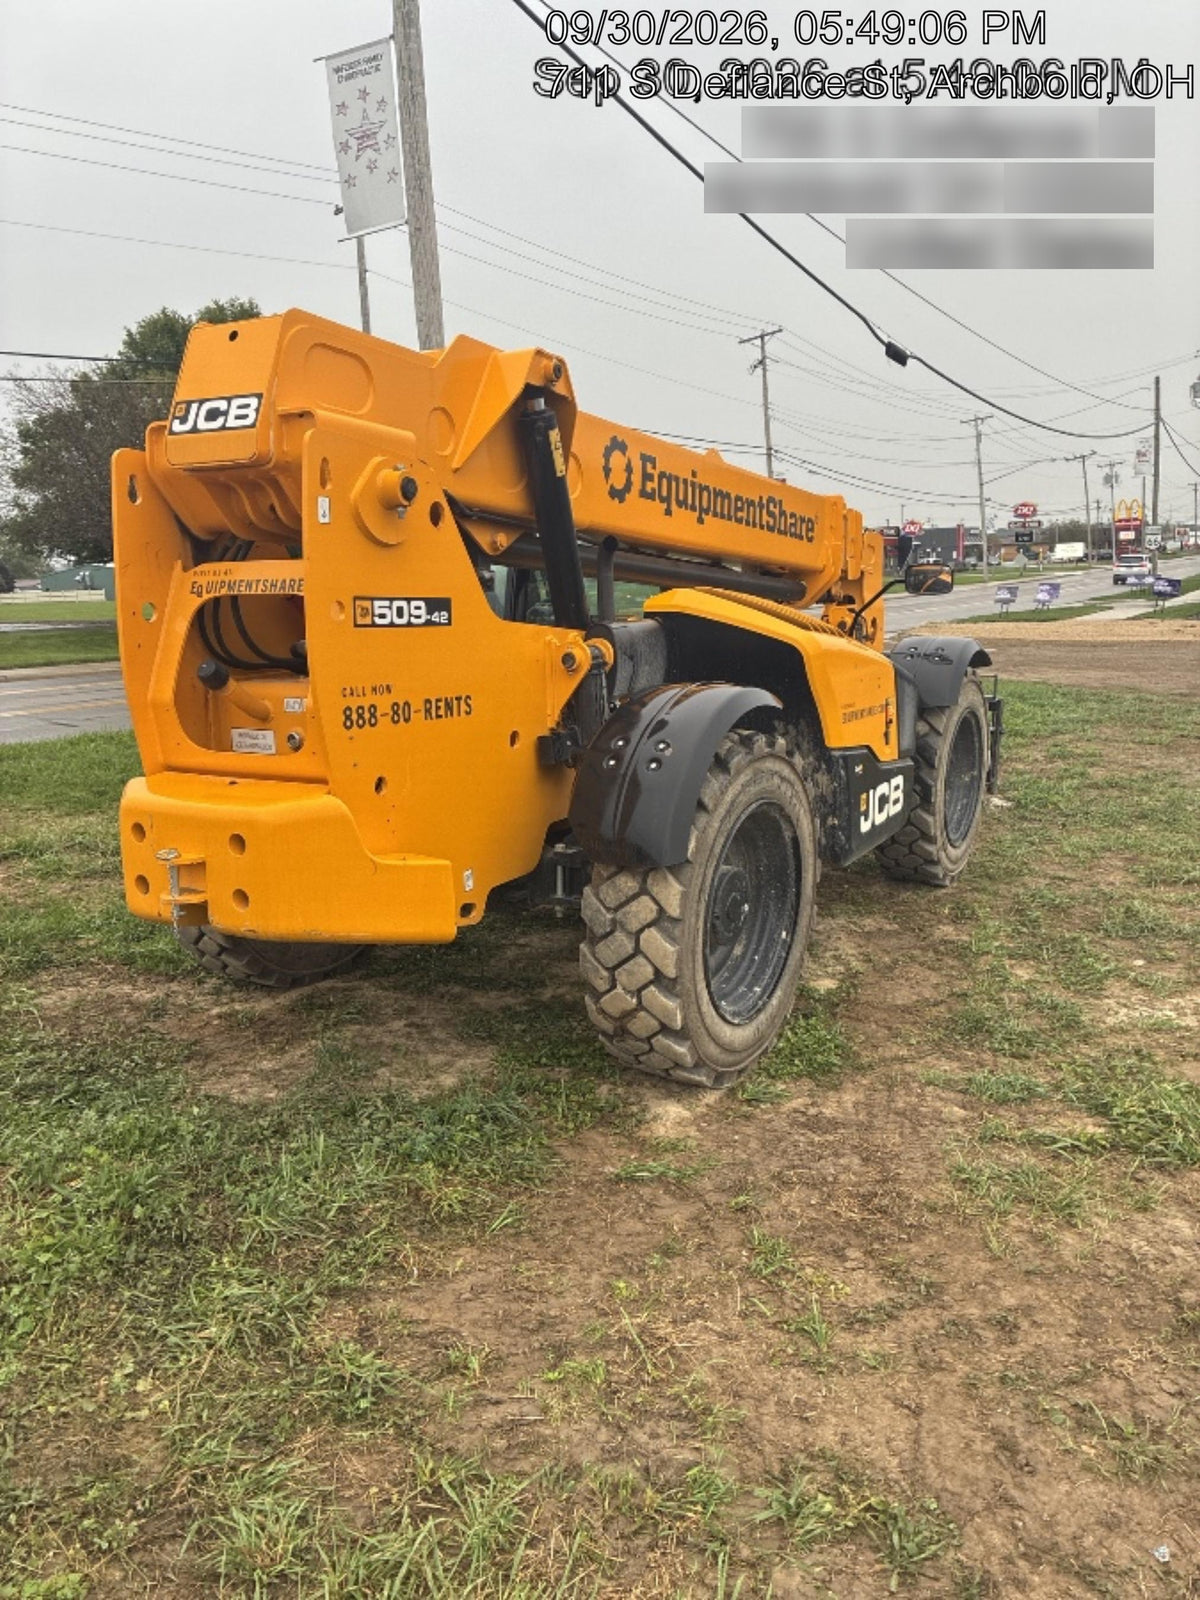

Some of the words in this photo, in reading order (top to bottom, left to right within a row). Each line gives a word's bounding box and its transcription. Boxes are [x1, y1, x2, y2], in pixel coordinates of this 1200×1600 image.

[171, 396, 259, 432] JCB
[639, 451, 815, 543] EquipmentShare
[373, 600, 449, 625] 509-42
[342, 687, 367, 698] CALL
[342, 695, 472, 730] 888-80-RENTS
[860, 774, 904, 833] JCB
